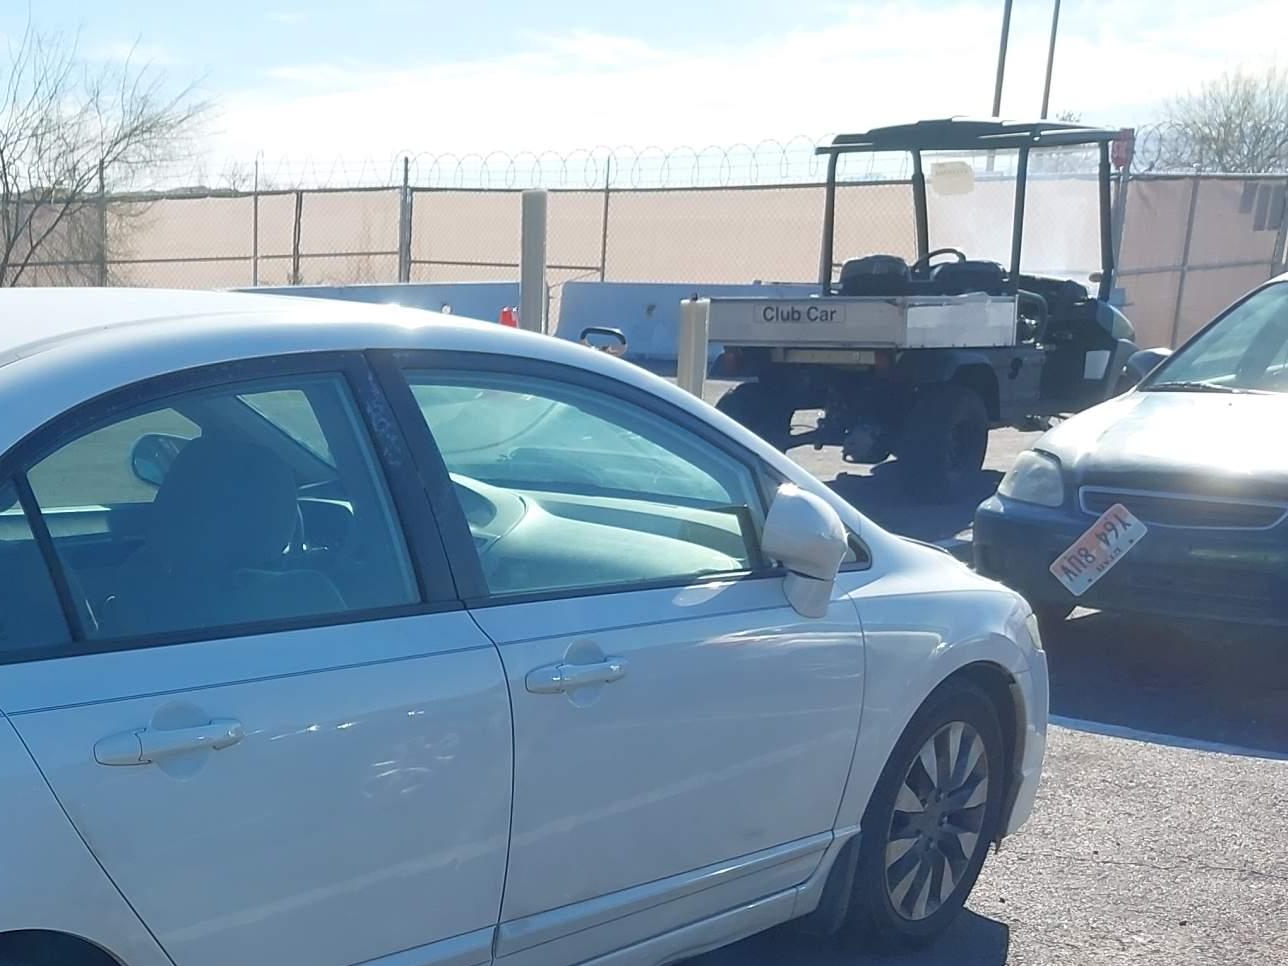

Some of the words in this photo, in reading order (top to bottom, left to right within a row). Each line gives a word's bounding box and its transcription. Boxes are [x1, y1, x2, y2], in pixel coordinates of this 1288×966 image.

[762, 306, 801, 321] Club
[807, 306, 837, 321] Car
[1095, 513, 1132, 547] Y64
[1061, 547, 1097, 582] 8UV
